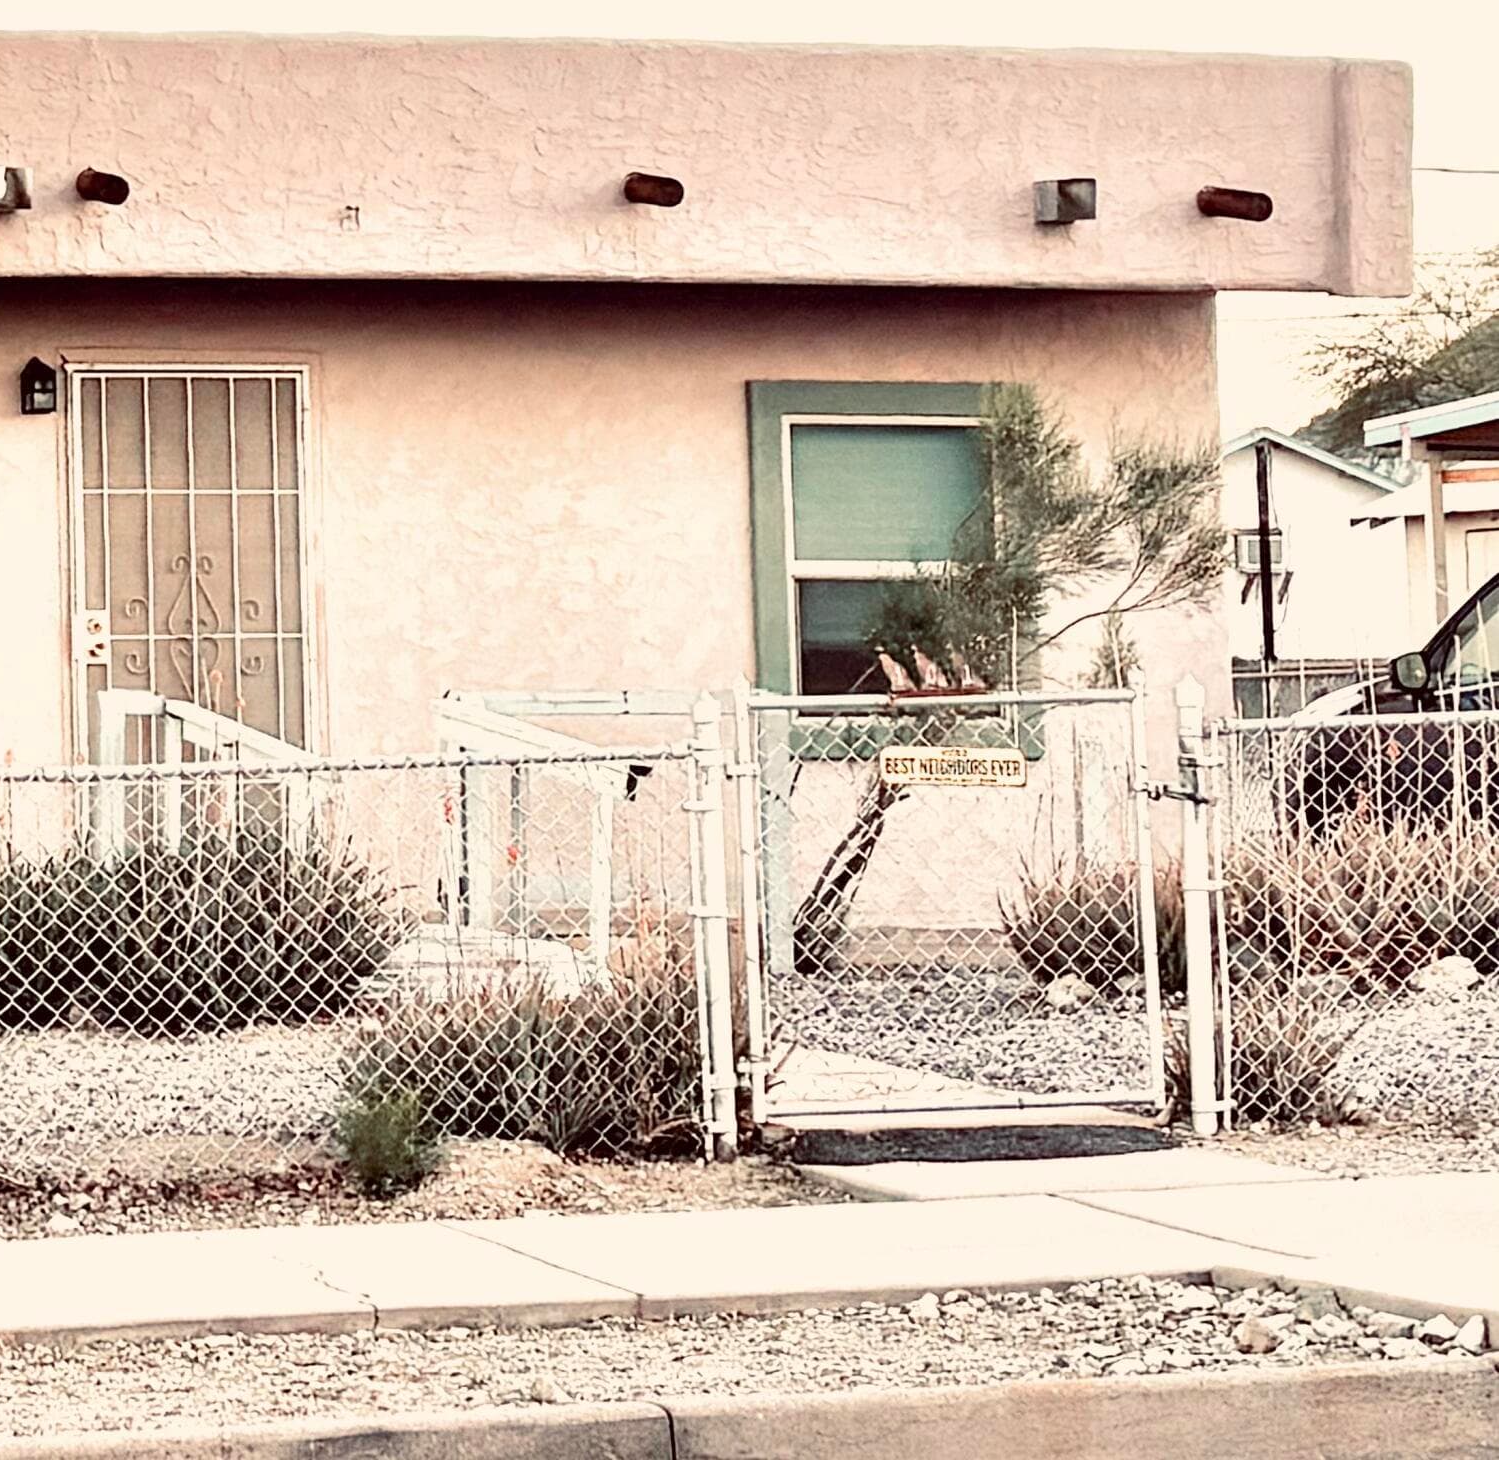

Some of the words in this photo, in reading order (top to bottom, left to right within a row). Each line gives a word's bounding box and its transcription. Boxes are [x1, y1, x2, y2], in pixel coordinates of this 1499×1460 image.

[885, 757, 916, 775] BEST
[919, 758, 988, 776] NEIGHBORS
[991, 759, 1021, 777] EVER
